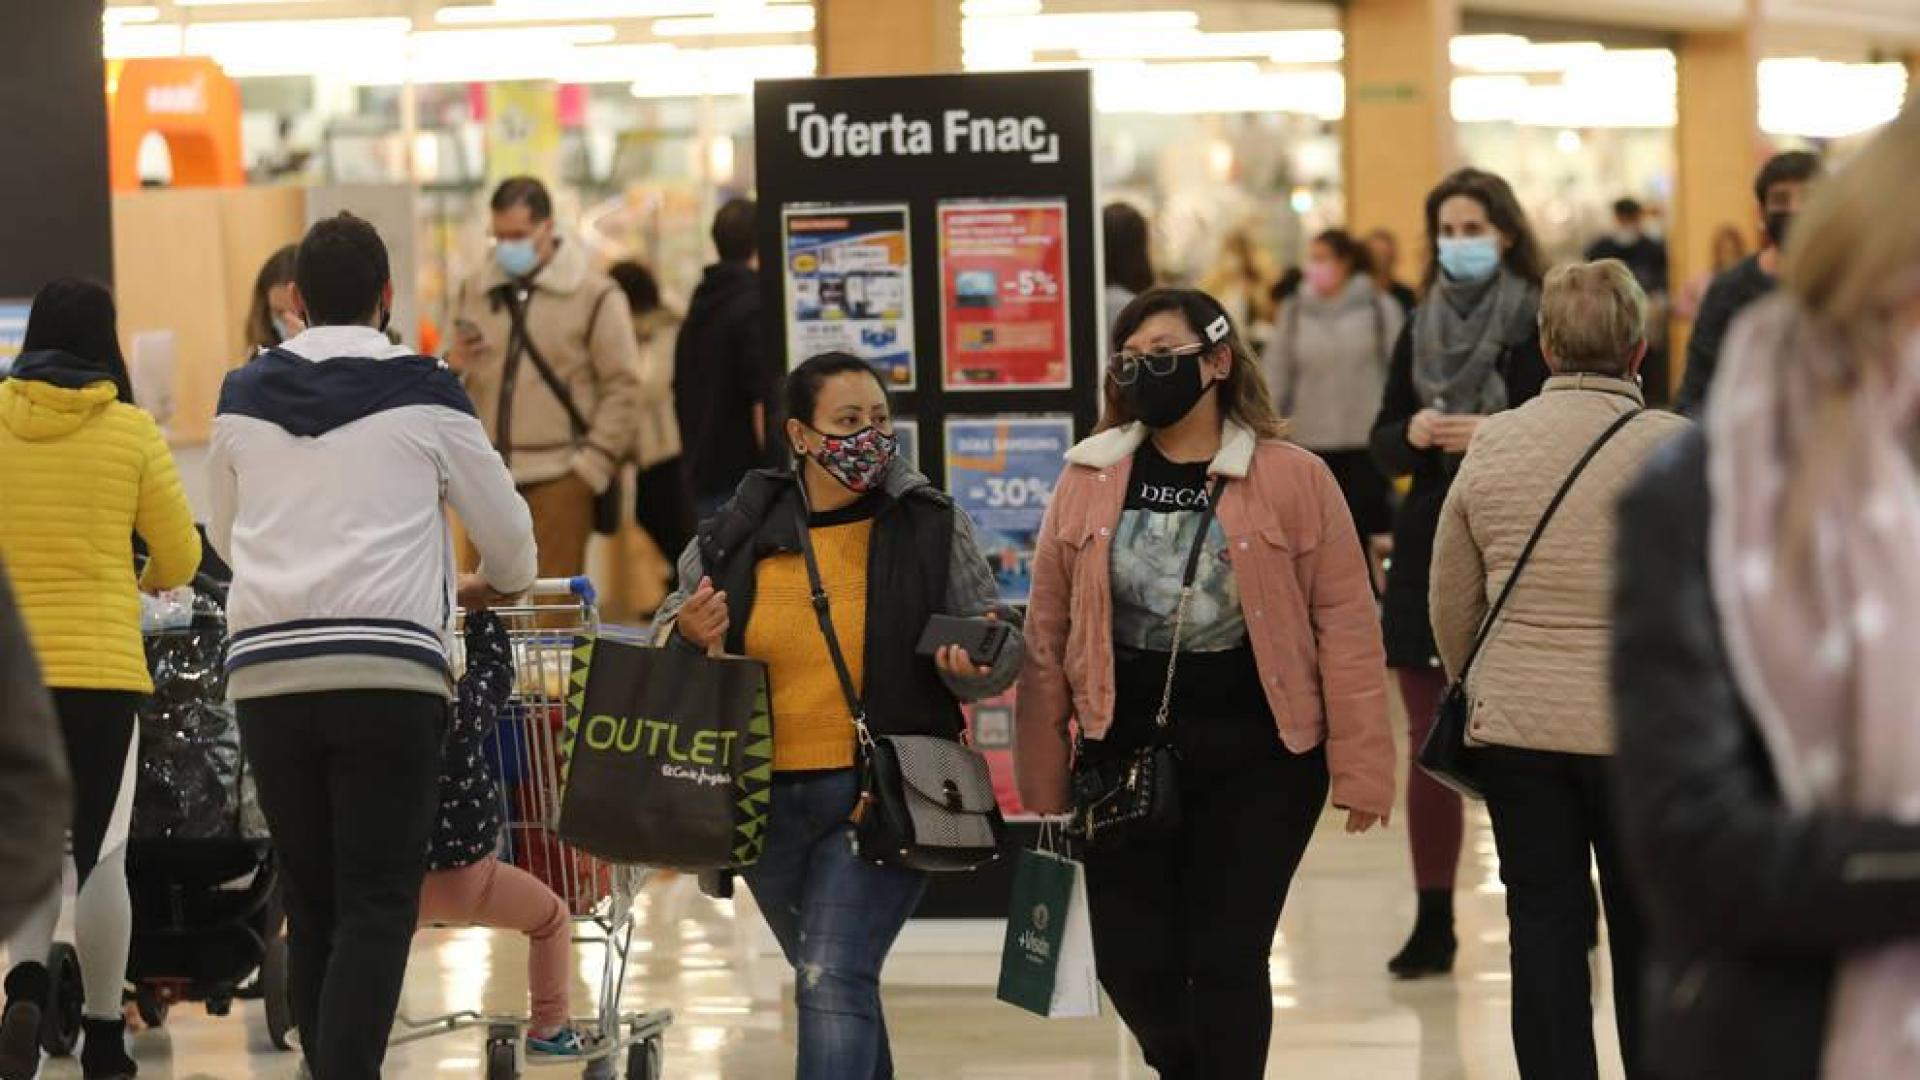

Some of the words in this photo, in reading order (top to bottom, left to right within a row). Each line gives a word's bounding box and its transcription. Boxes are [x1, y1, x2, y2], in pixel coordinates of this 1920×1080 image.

[800, 112, 932, 158] Oferta
[943, 110, 1046, 153] Fnac
[1003, 269, 1057, 297] -5%
[968, 477, 1050, 506] -30%
[1141, 482, 1209, 507] DEGA
[585, 714, 738, 767] OUTLET
